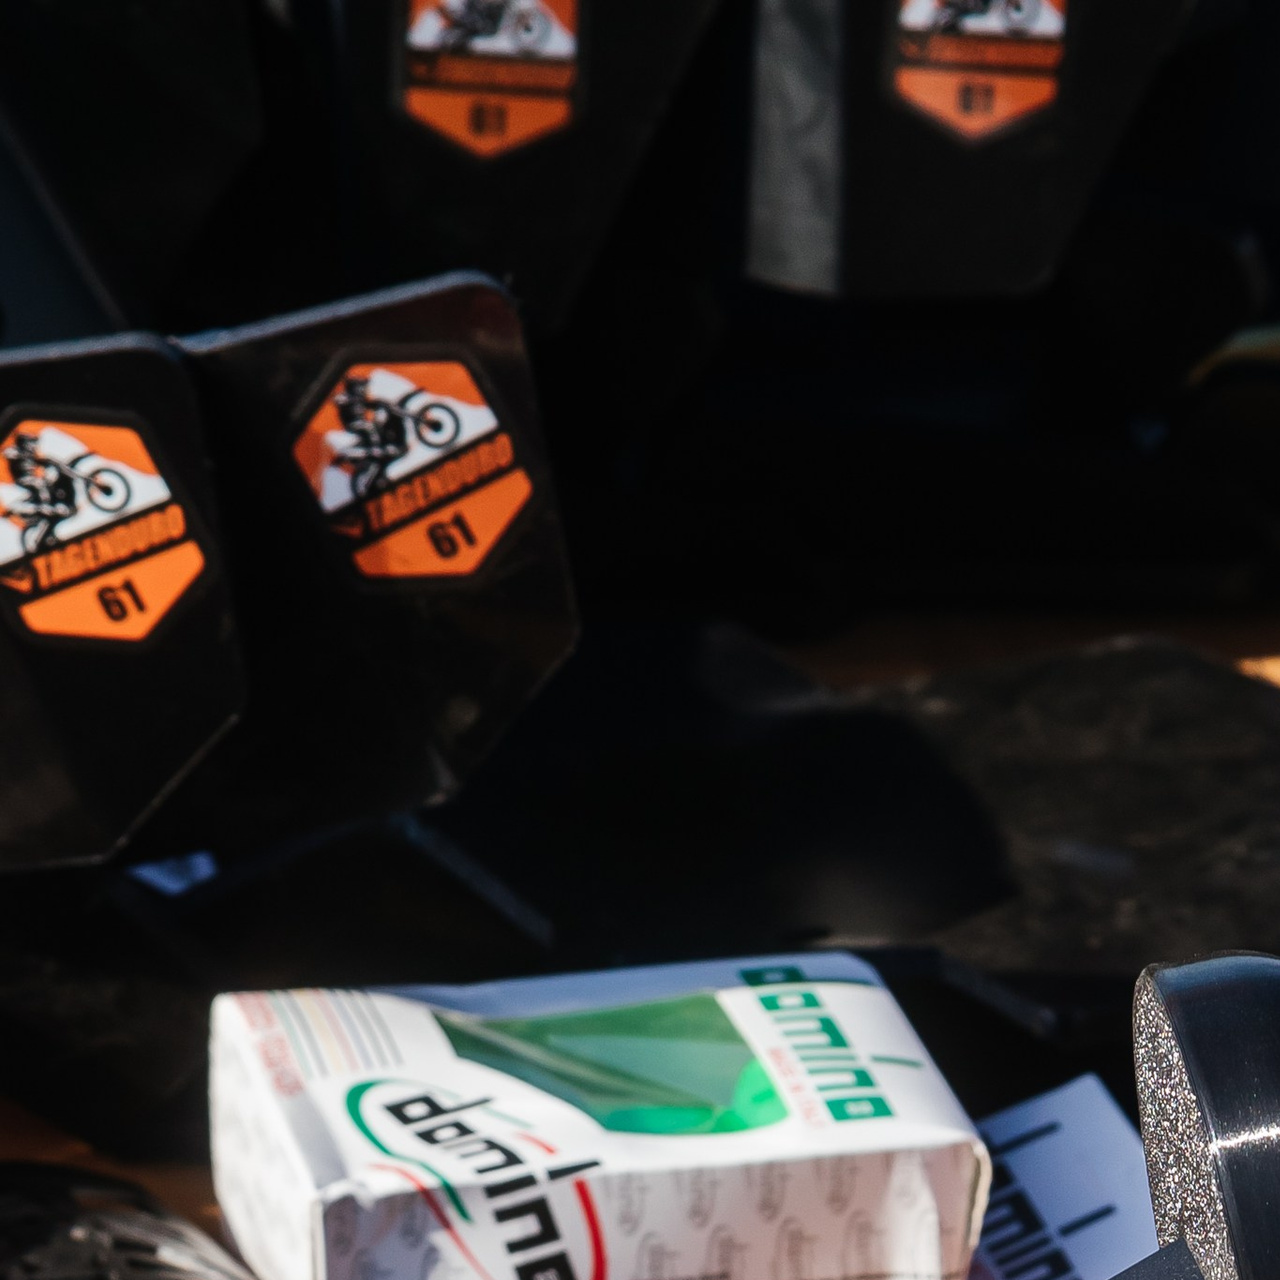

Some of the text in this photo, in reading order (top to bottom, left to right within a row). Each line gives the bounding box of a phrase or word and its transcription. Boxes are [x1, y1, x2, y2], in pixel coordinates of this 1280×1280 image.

[427, 512, 477, 559] 61
[97, 578, 147, 622] 61
[739, 966, 924, 1121] domino
